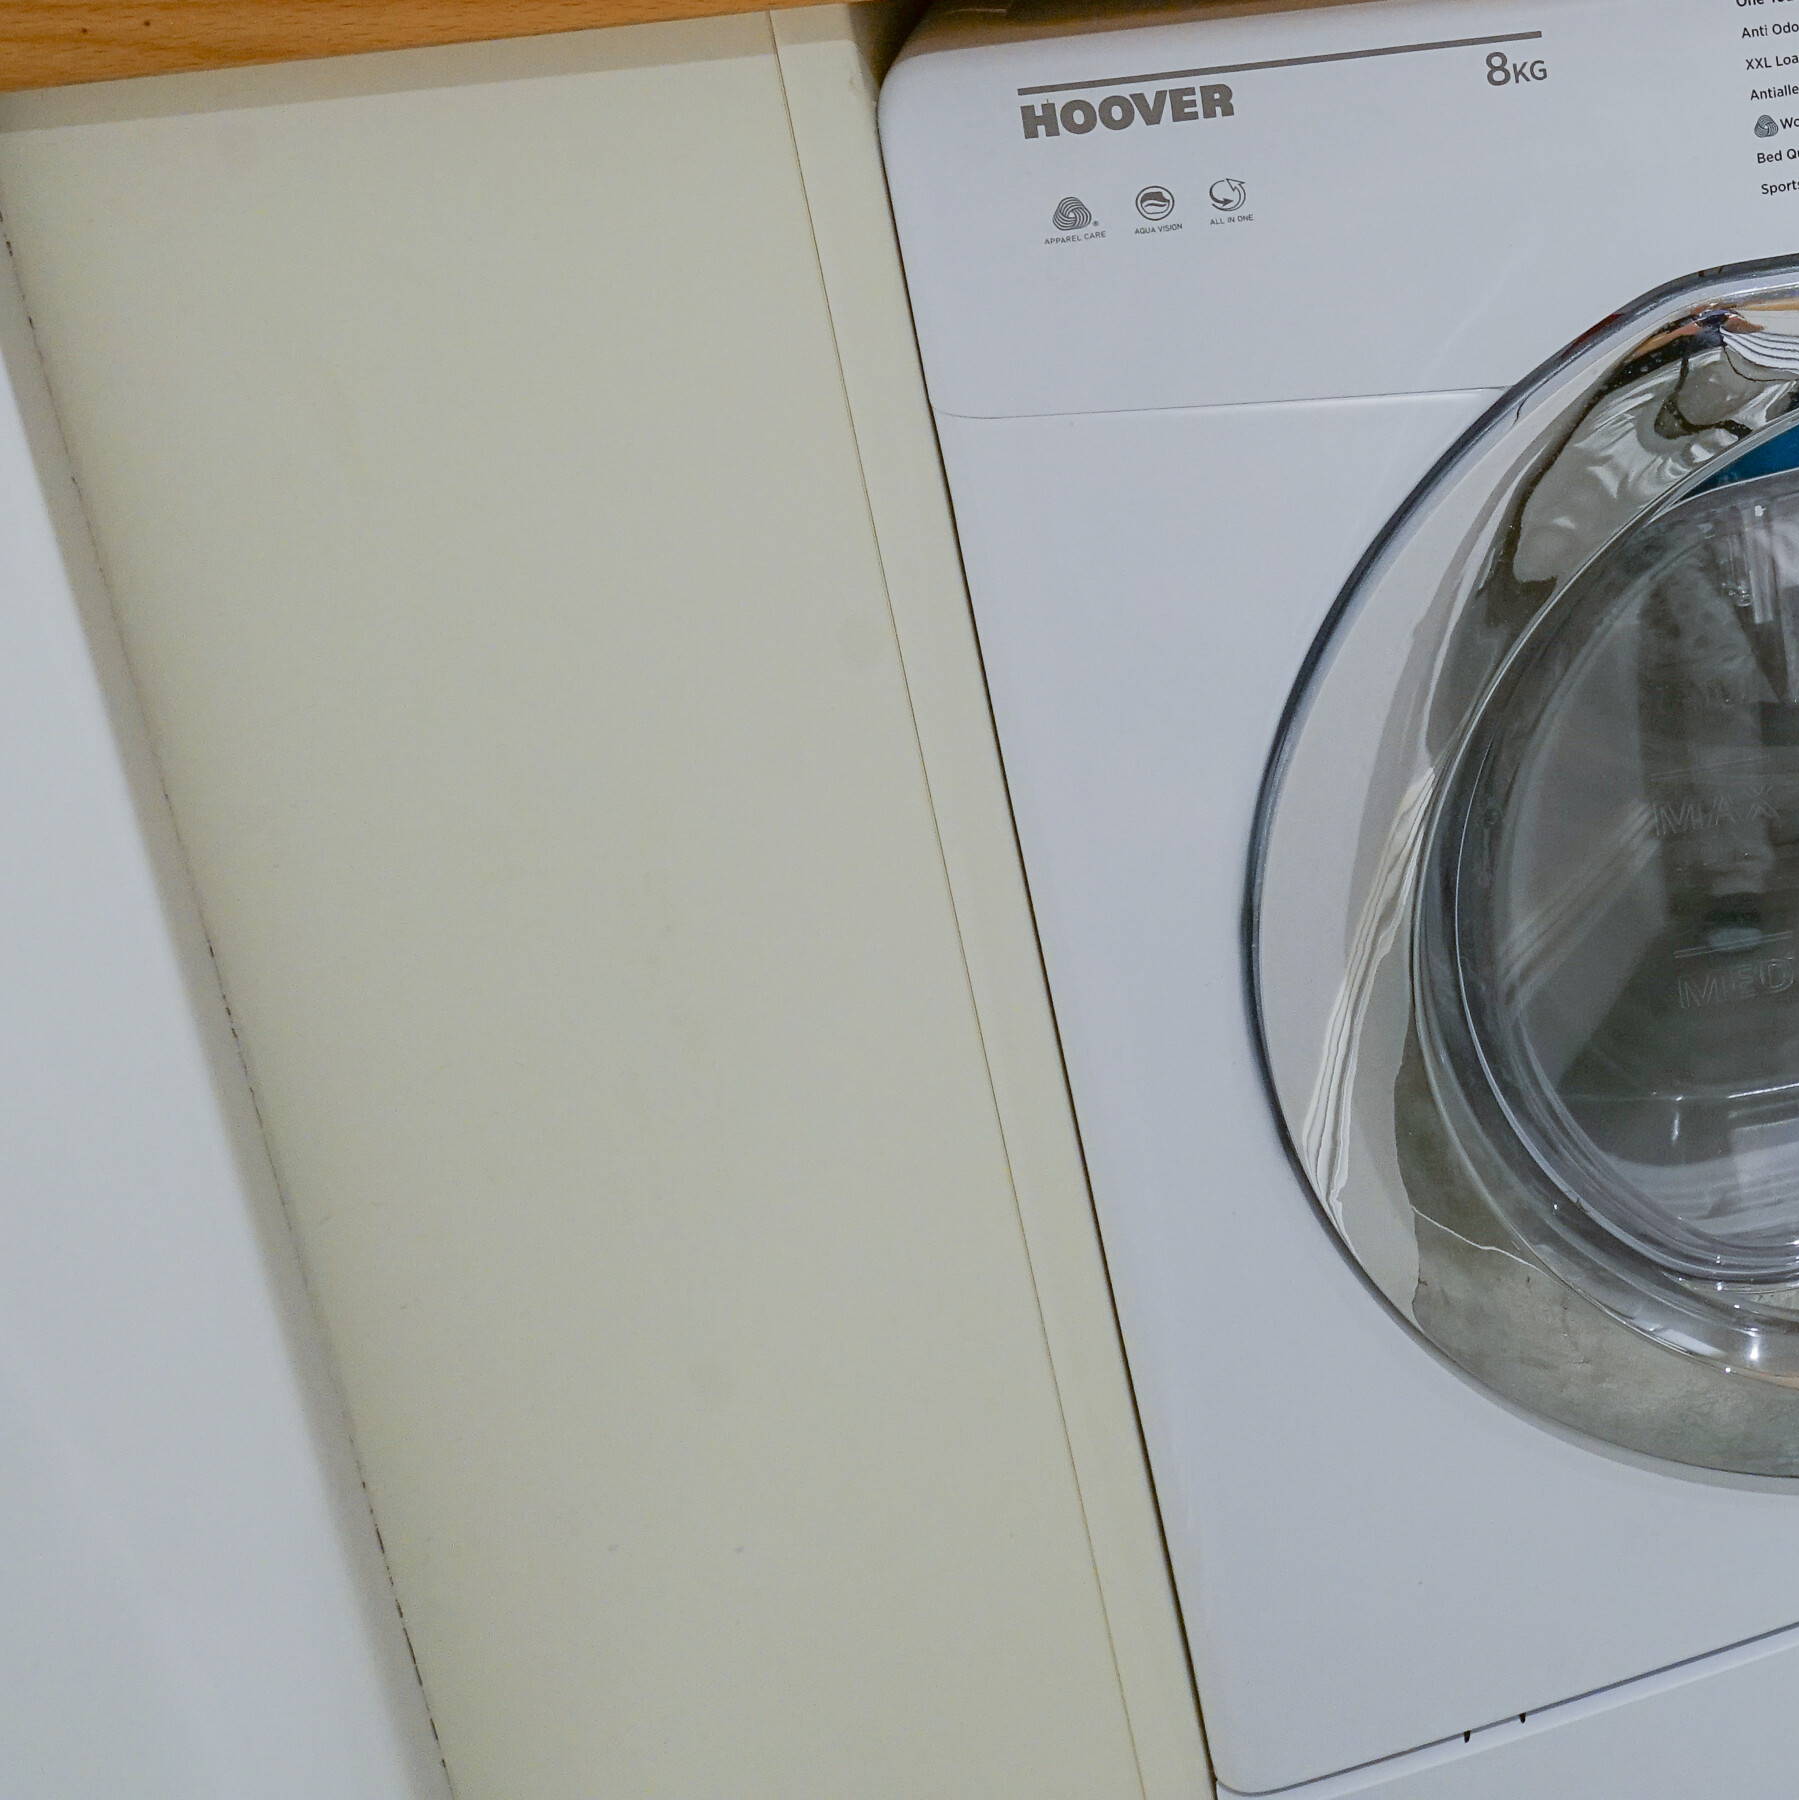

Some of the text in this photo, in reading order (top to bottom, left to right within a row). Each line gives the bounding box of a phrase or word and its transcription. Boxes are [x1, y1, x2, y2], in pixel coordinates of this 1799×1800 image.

[1741, 24, 1768, 39] Anti
[1484, 50, 1549, 88] 8KG
[1745, 57, 1772, 71] XXL
[1019, 83, 1235, 140] HOOVER
[1757, 150, 1783, 164] Bed
[1209, 213, 1255, 226] ALL ONE
[1134, 222, 1183, 236] AQUA VISION
[1044, 230, 1107, 246] APPAREL CARE
